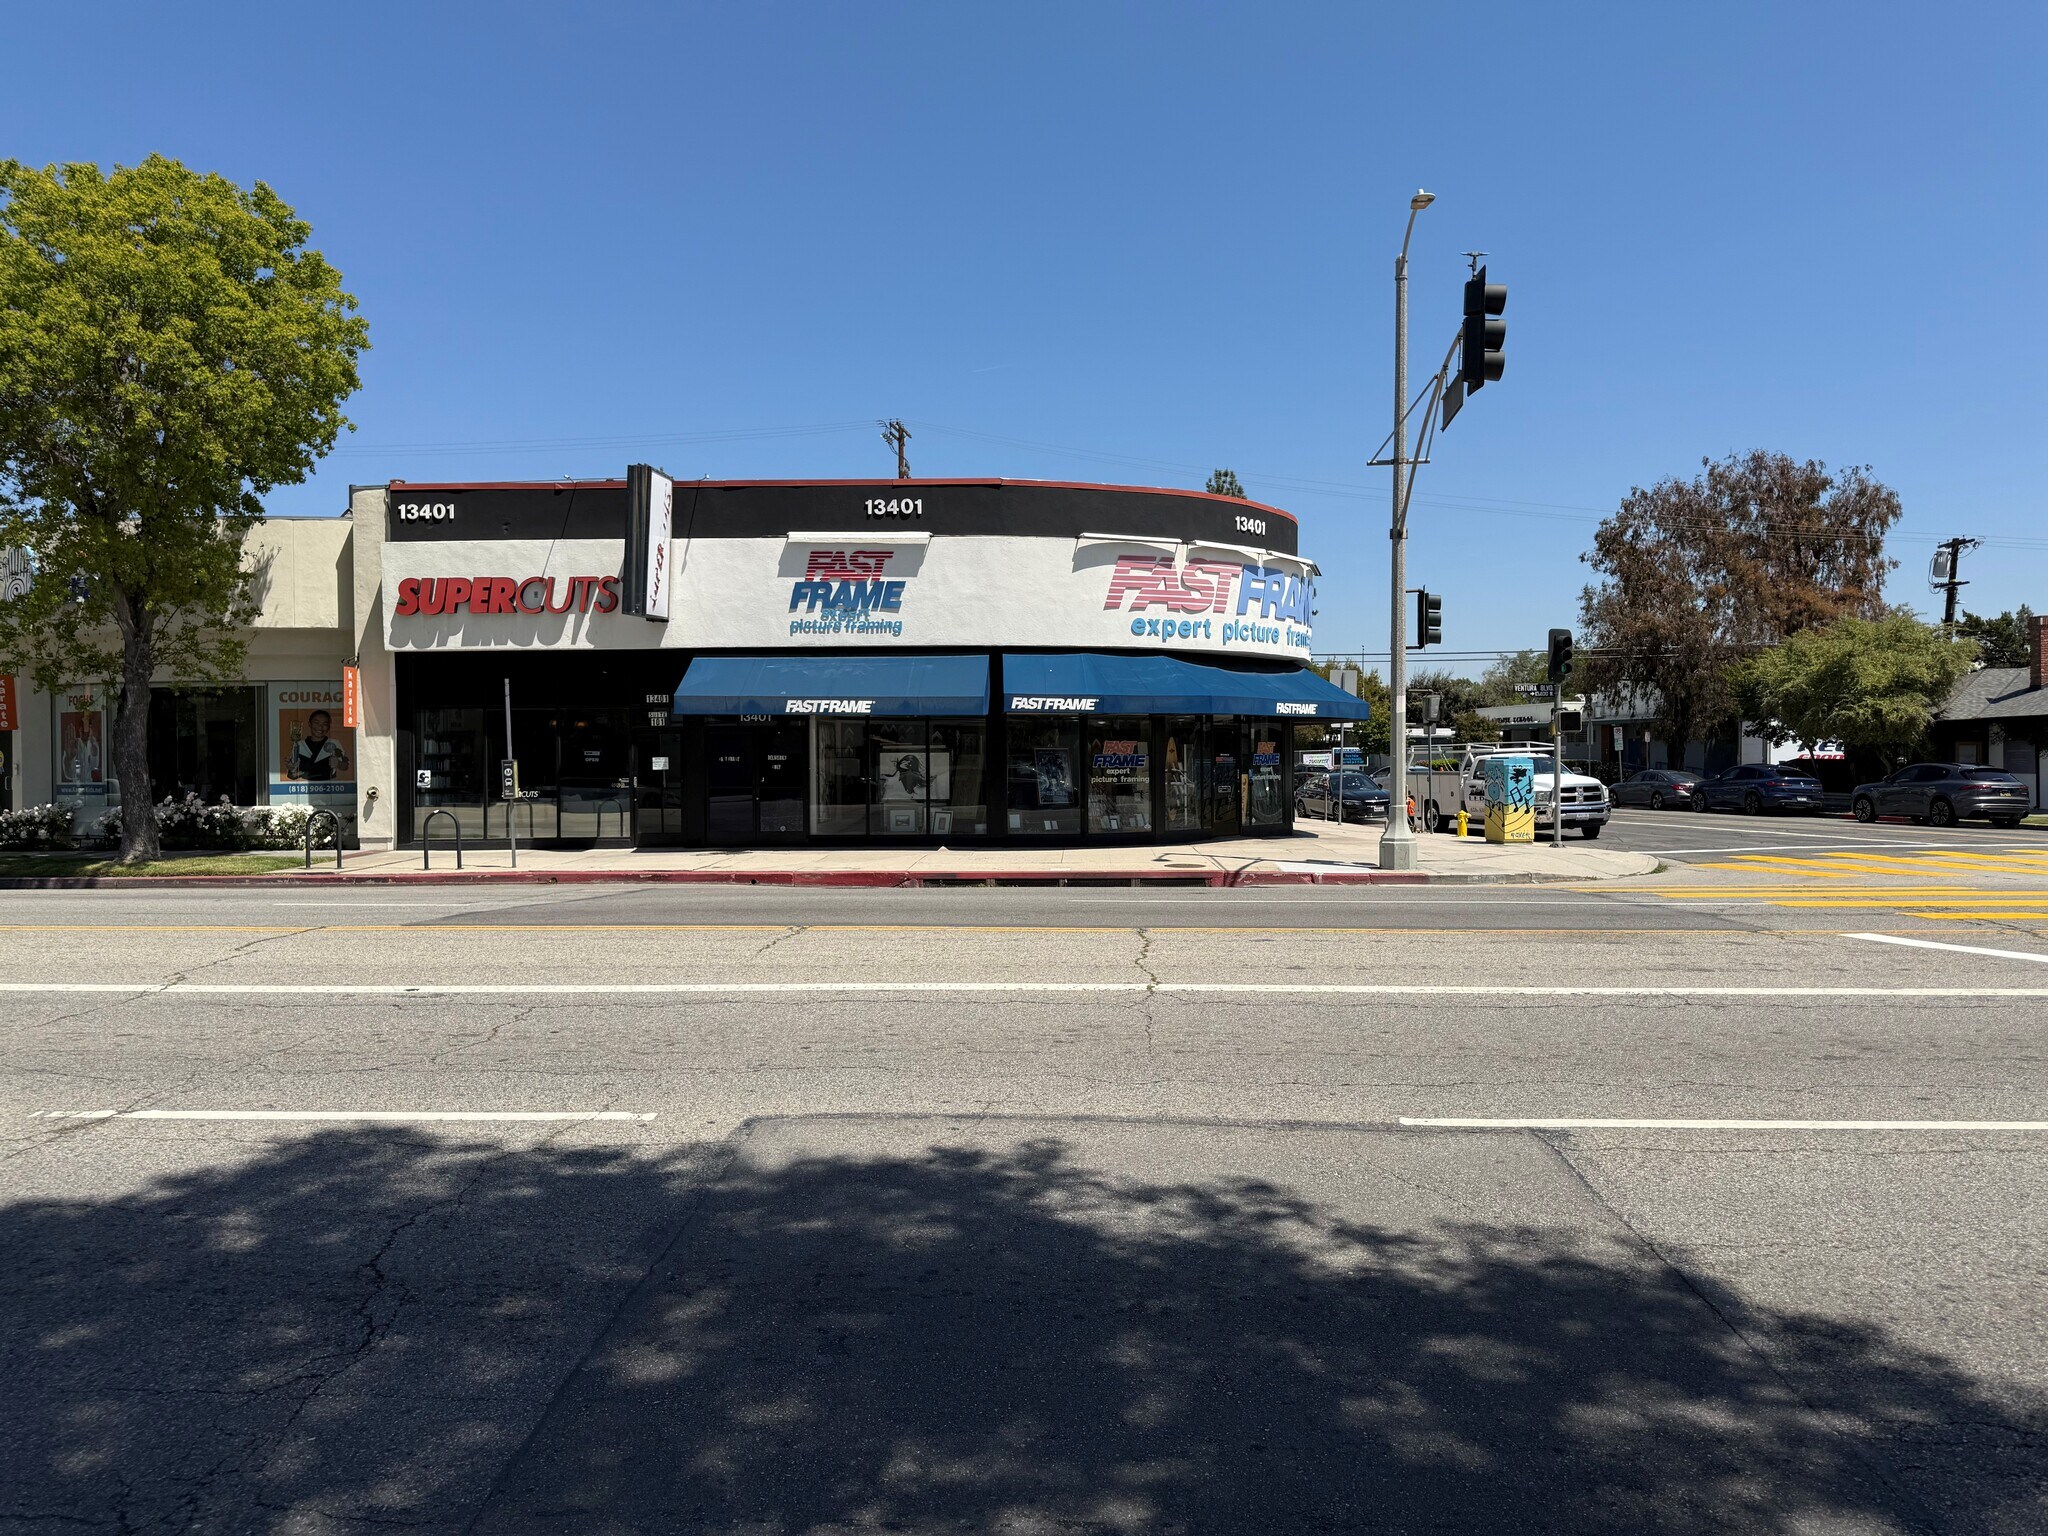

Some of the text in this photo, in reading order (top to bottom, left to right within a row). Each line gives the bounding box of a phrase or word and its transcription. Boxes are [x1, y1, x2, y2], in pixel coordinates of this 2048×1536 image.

[397, 503, 455, 520] 13401
[865, 498, 922, 515] 13401
[1235, 515, 1266, 536] 13401
[804, 550, 894, 581] FAST
[395, 576, 619, 616] SUPERCUTS
[788, 580, 906, 611] FRAME
[789, 619, 903, 637] picture framing
[1130, 617, 1212, 643] expert
[1222, 618, 1280, 645] picture
[279, 691, 344, 703] COURAG
[1103, 740, 1138, 754] FAST
[1092, 754, 1147, 768] FRAME
[1252, 753, 1280, 766] FRAME
[1106, 767, 1130, 775] expert
[288, 784, 345, 793] (818) 906-2100
[1091, 776, 1150, 784] picture framing
